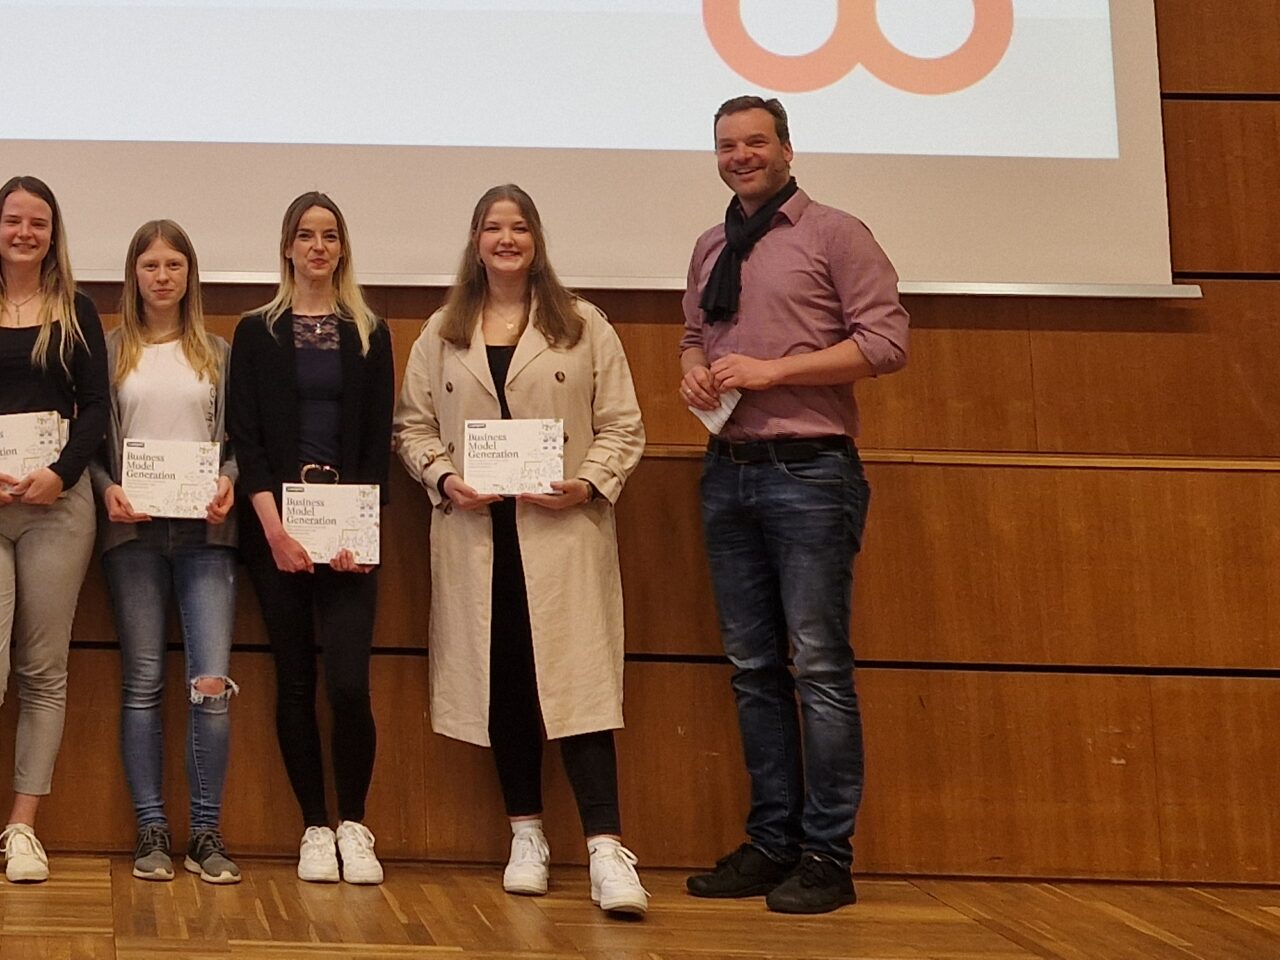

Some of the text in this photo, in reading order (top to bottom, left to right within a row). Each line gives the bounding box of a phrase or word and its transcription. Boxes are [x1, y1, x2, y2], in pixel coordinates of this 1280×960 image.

[468, 432, 507, 442] Business
[468, 442, 497, 450] Model
[127, 452, 165, 462] Business
[467, 450, 519, 459] Generation
[127, 461, 155, 471] Model
[126, 470, 176, 480] Generation
[287, 498, 325, 507] Business
[287, 507, 315, 517] Model
[286, 516, 337, 525] Generation
